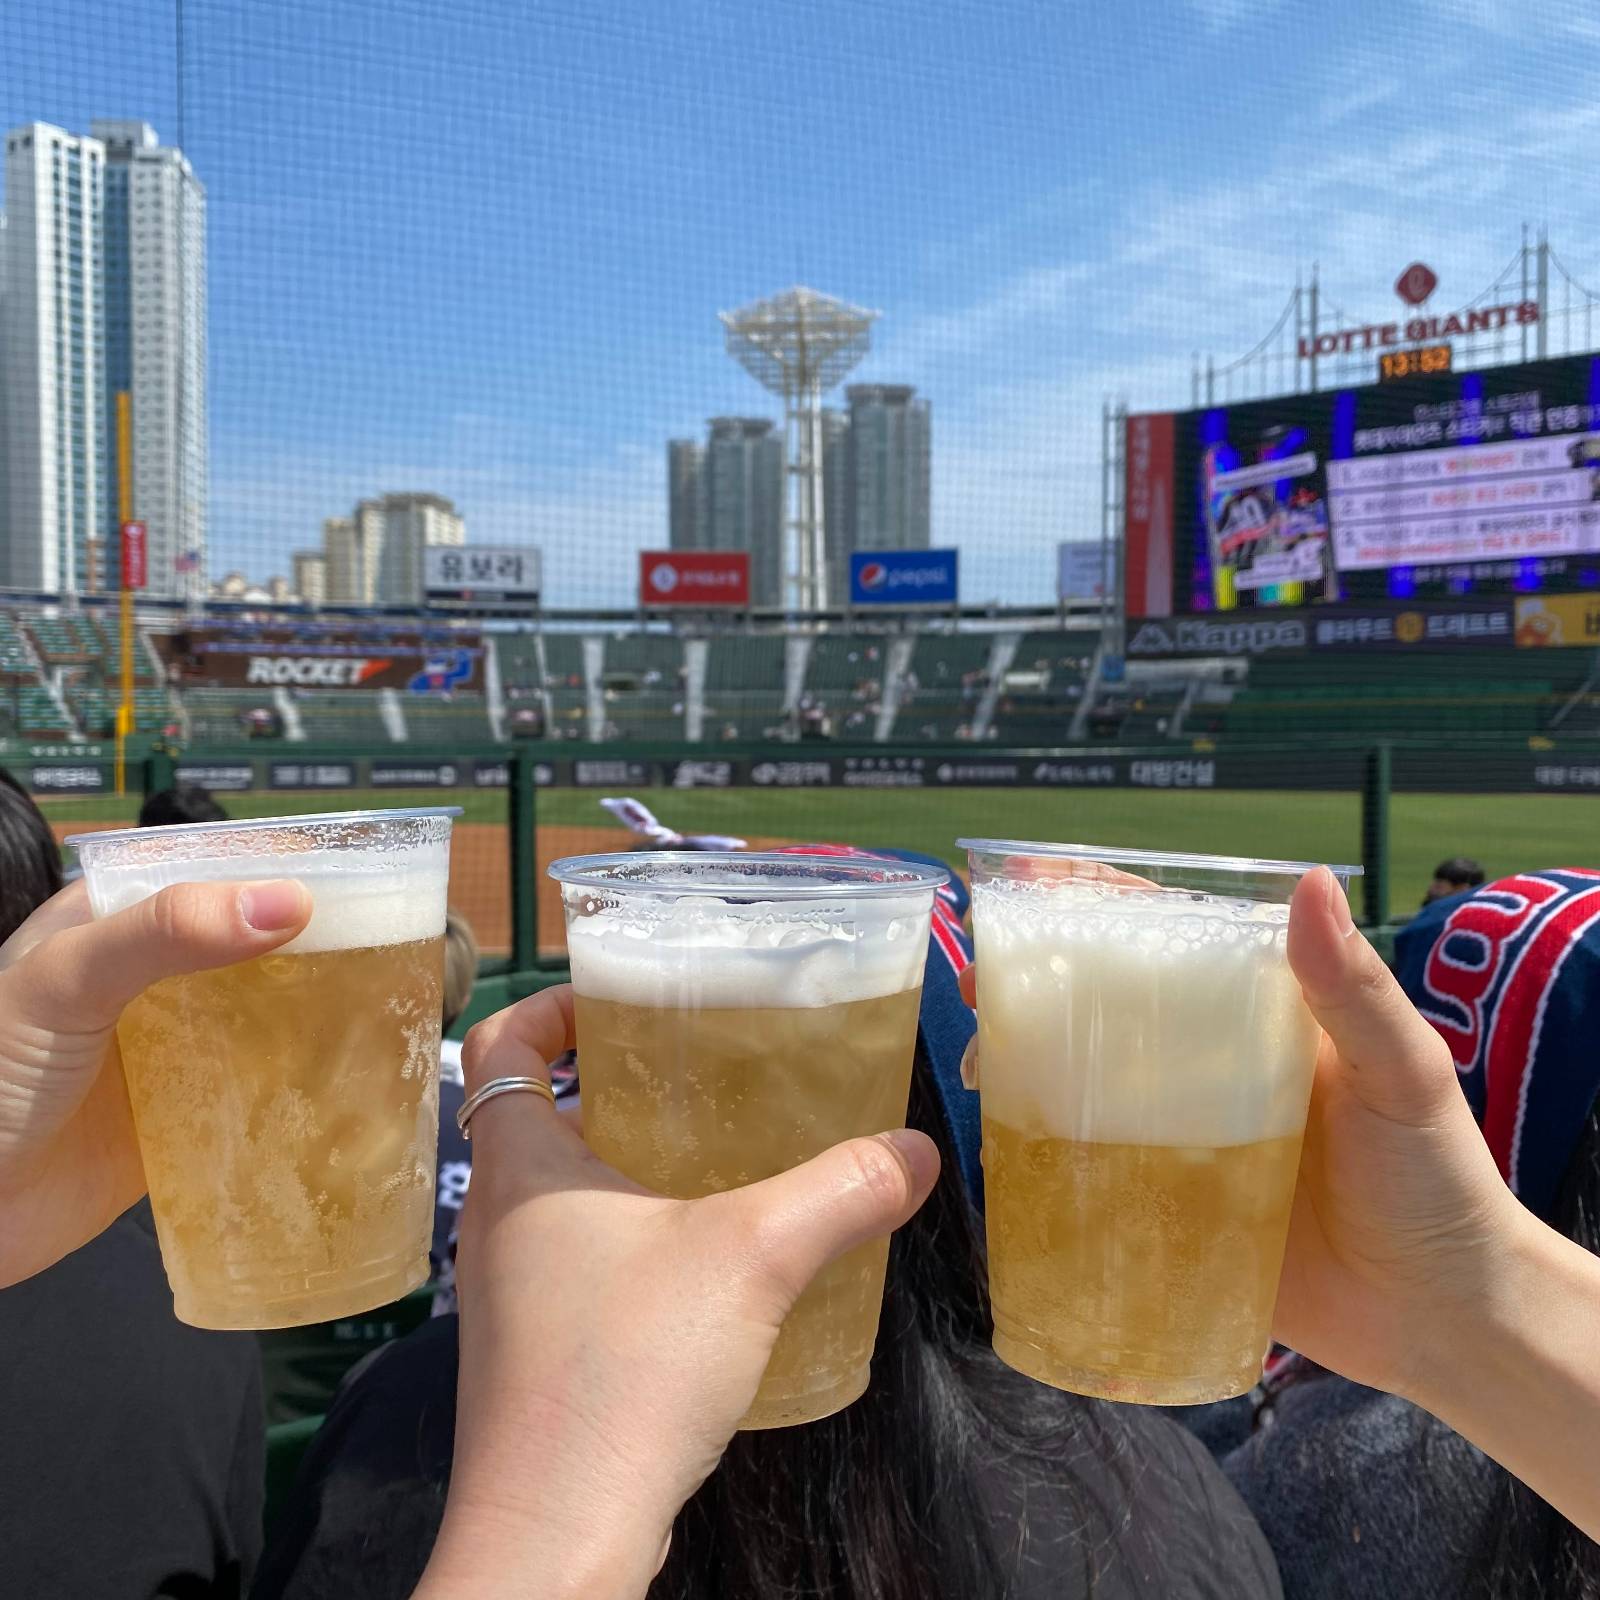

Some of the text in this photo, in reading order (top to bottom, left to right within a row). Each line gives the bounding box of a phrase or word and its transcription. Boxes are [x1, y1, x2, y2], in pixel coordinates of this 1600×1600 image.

[1298, 301, 1541, 358] LOTTE GIANTS
[888, 565, 948, 588] pepsi
[1176, 620, 1305, 653] Kappa
[247, 658, 364, 684] ROCKET
[1130, 760, 1216, 786] 대방건설
